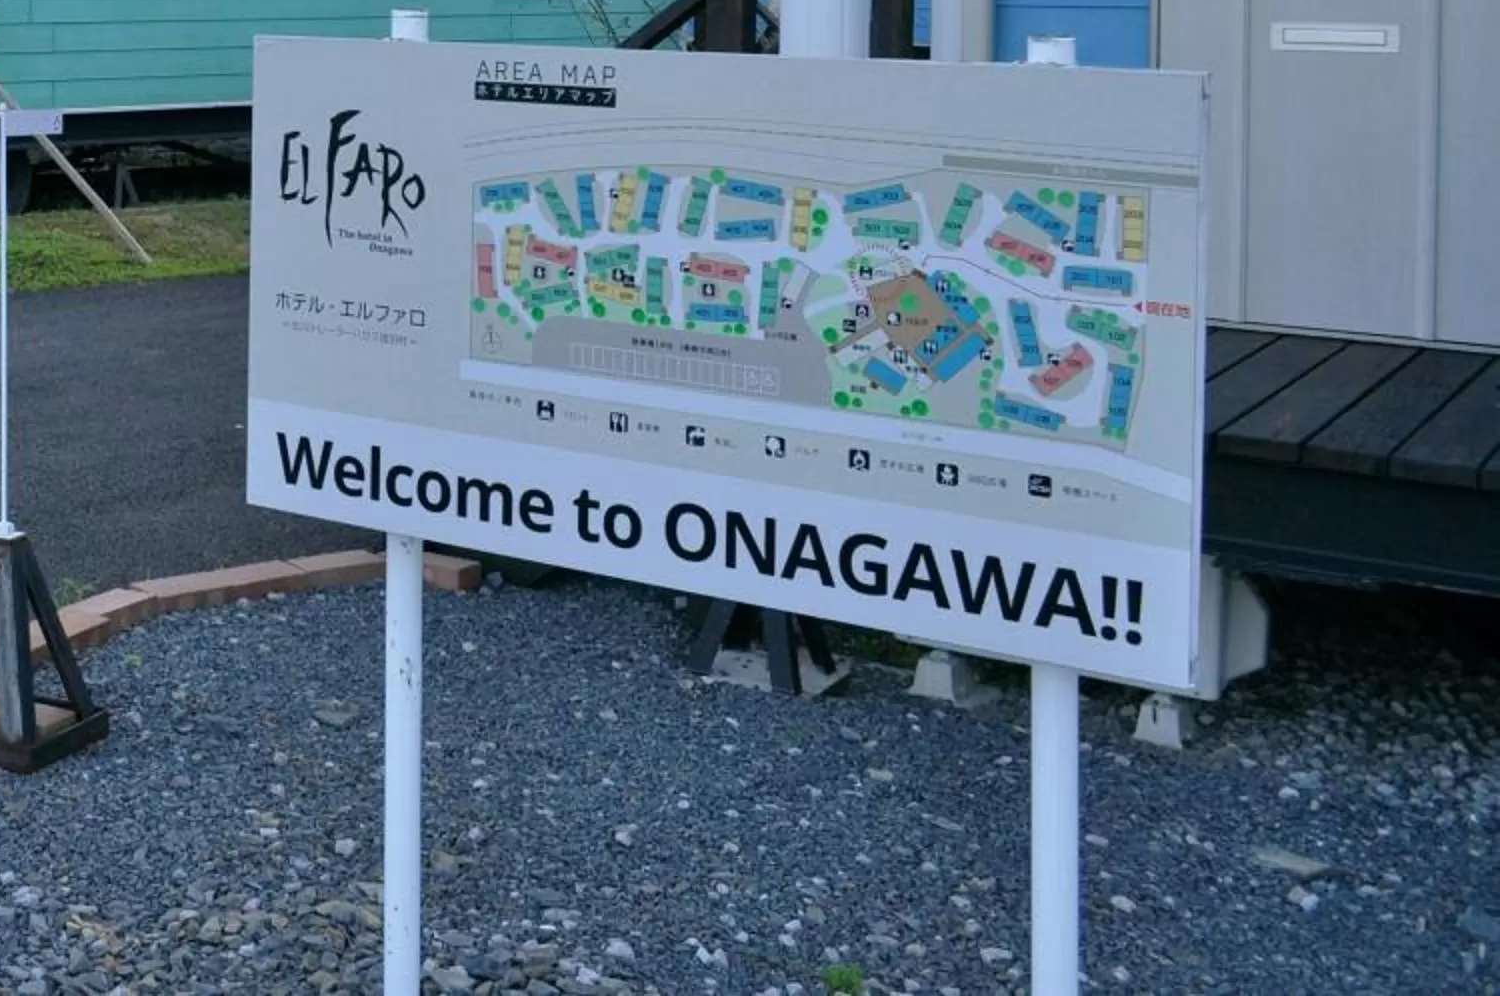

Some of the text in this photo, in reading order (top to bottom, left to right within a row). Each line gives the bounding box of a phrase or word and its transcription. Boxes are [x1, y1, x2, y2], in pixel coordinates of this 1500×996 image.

[476, 60, 616, 84] AREA MAP
[477, 83, 614, 104] ホテルエリアマップ
[280, 131, 317, 205] EL
[275, 291, 426, 328] ホテル・エルファロ
[276, 432, 1143, 646] Welcome to ONAGAWA!!
